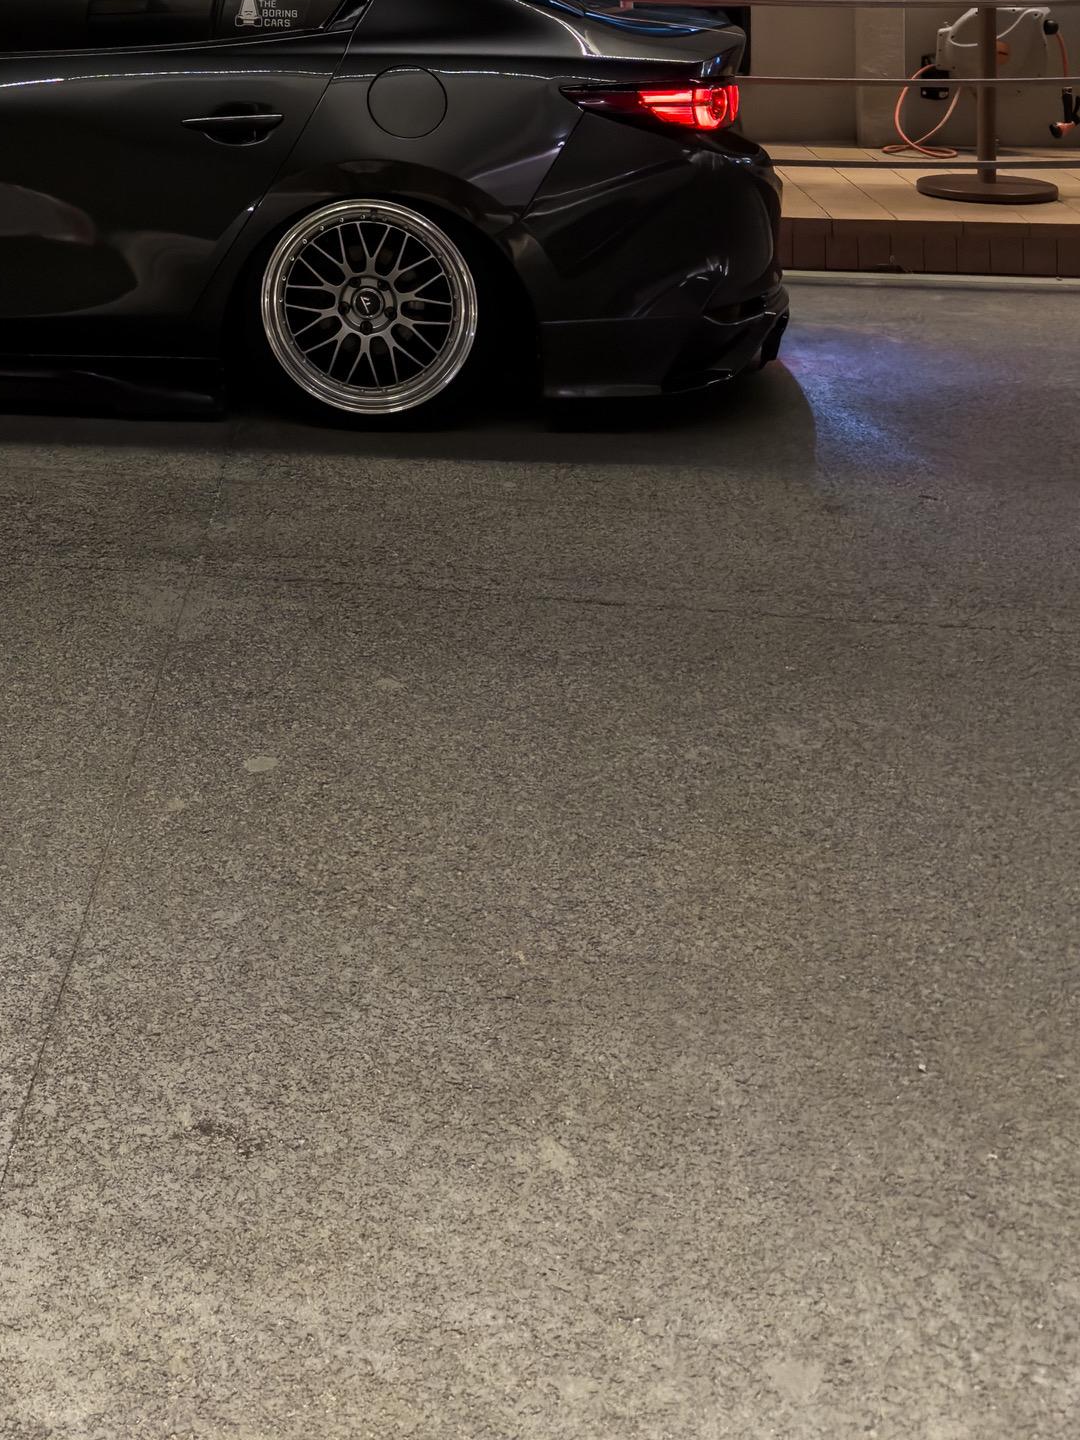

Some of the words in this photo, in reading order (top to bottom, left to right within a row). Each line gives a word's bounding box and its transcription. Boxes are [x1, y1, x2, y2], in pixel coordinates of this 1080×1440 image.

[259, 0, 277, 8] THE
[262, 9, 298, 18] BORING
[264, 19, 291, 28] CARS
